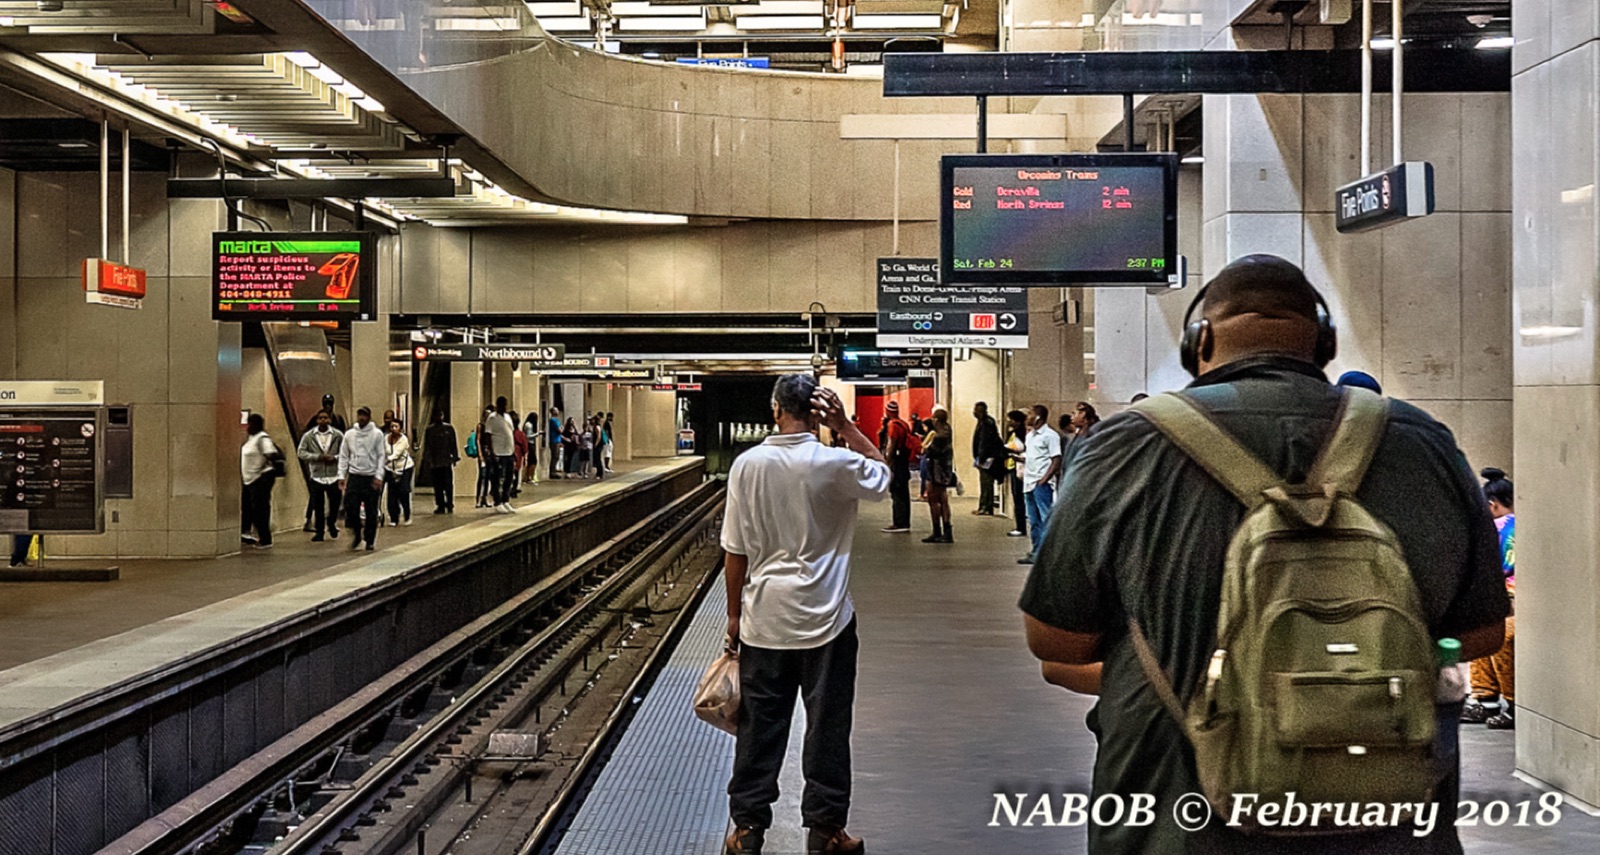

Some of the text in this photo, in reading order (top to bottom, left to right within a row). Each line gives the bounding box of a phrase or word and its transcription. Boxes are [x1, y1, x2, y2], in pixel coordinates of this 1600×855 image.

[1017, 170, 1098, 181] Upcoming Trains
[953, 186, 973, 196] Gold
[1102, 186, 1110, 196] 2
[1113, 187, 1130, 196] min
[953, 200, 1132, 210] Red North Springs 12 min
[1357, 185, 1379, 215] Points
[219, 241, 272, 253] marta
[219, 255, 309, 265] Report suspicious
[978, 258, 996, 268] Feb
[1000, 258, 1013, 268] 24
[1127, 258, 1165, 268] 2:37 PM
[219, 264, 257, 273] activity
[273, 264, 302, 272] items
[219, 273, 306, 281] the MARTA Police
[219, 282, 294, 291] Department at
[889, 312, 932, 320] Eastbound
[908, 337, 985, 345] Underground Atlanta
[478, 347, 542, 358] Northbound
[881, 357, 920, 366] Elevator
